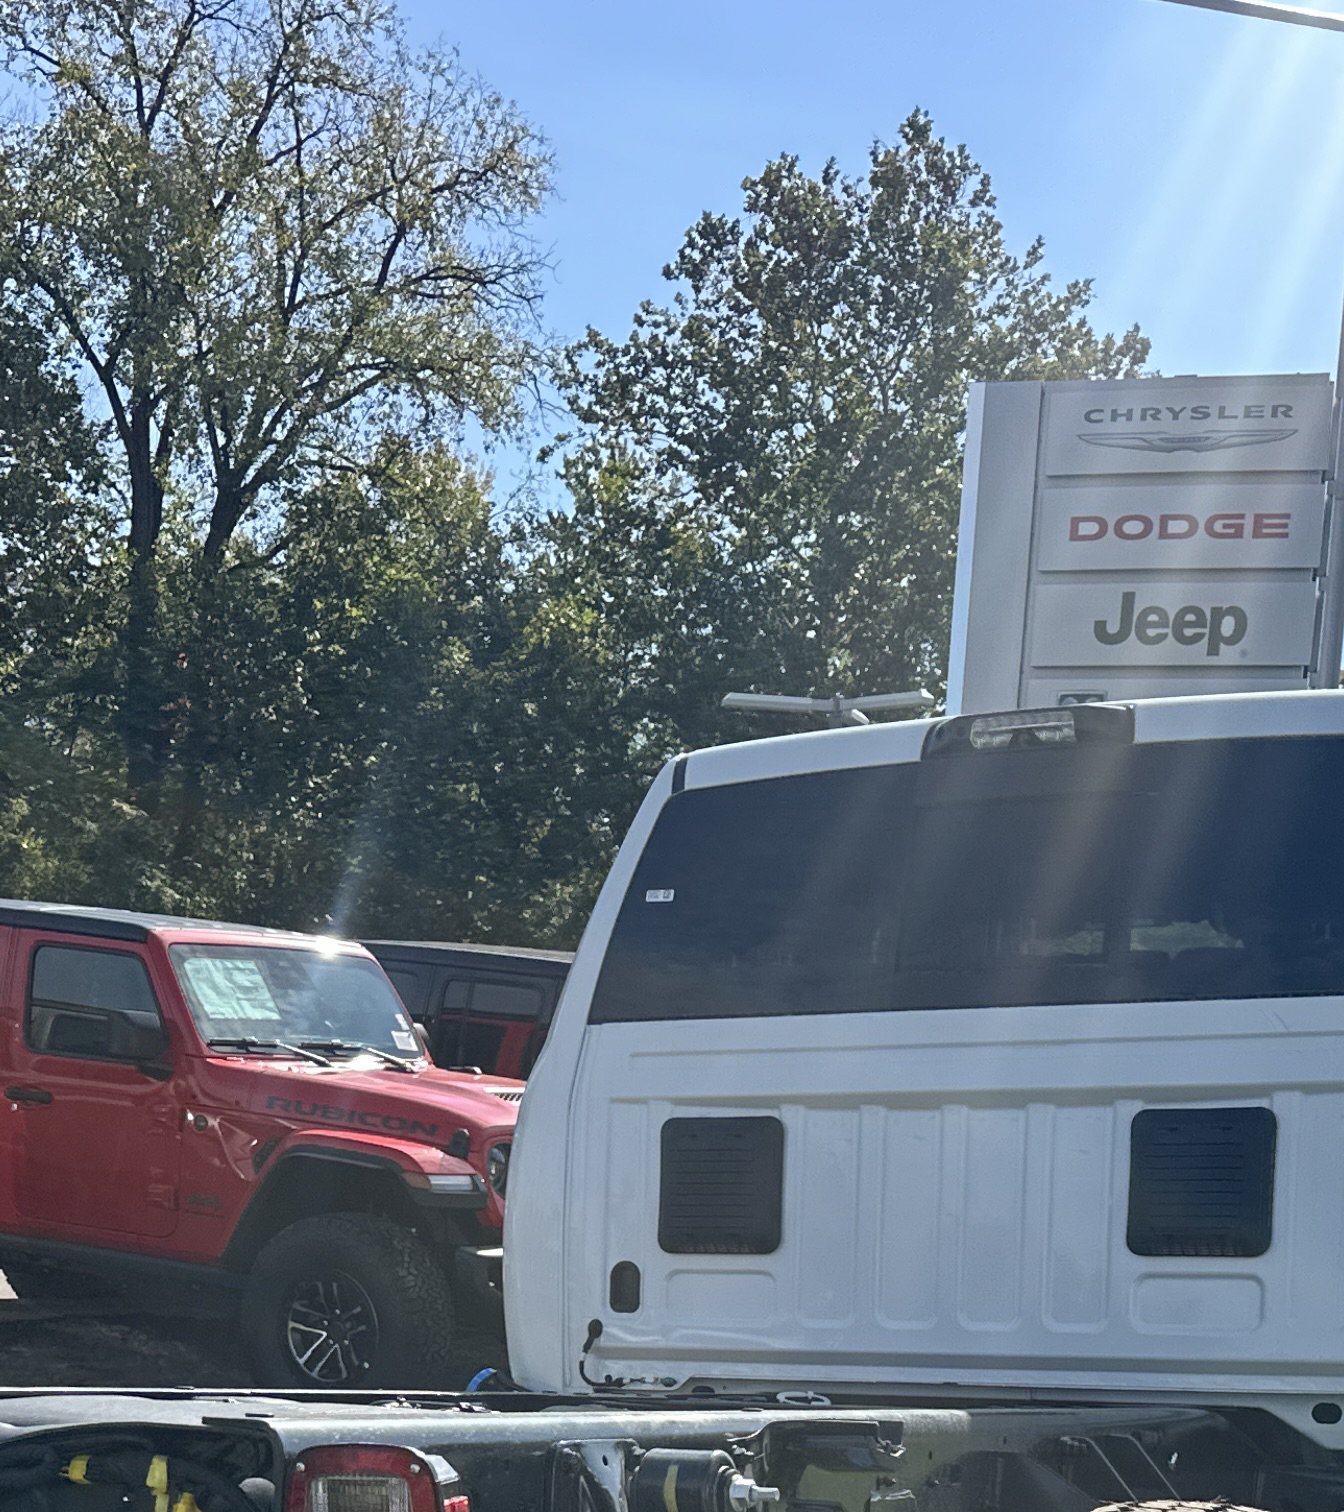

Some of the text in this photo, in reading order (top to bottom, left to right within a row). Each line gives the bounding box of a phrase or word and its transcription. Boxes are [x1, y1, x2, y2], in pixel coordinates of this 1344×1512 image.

[1083, 404, 1294, 424] CHRYSLER
[1068, 513, 1292, 542] DODGE
[1093, 591, 1248, 656] Jeep
[265, 1096, 438, 1137] RUBICON
